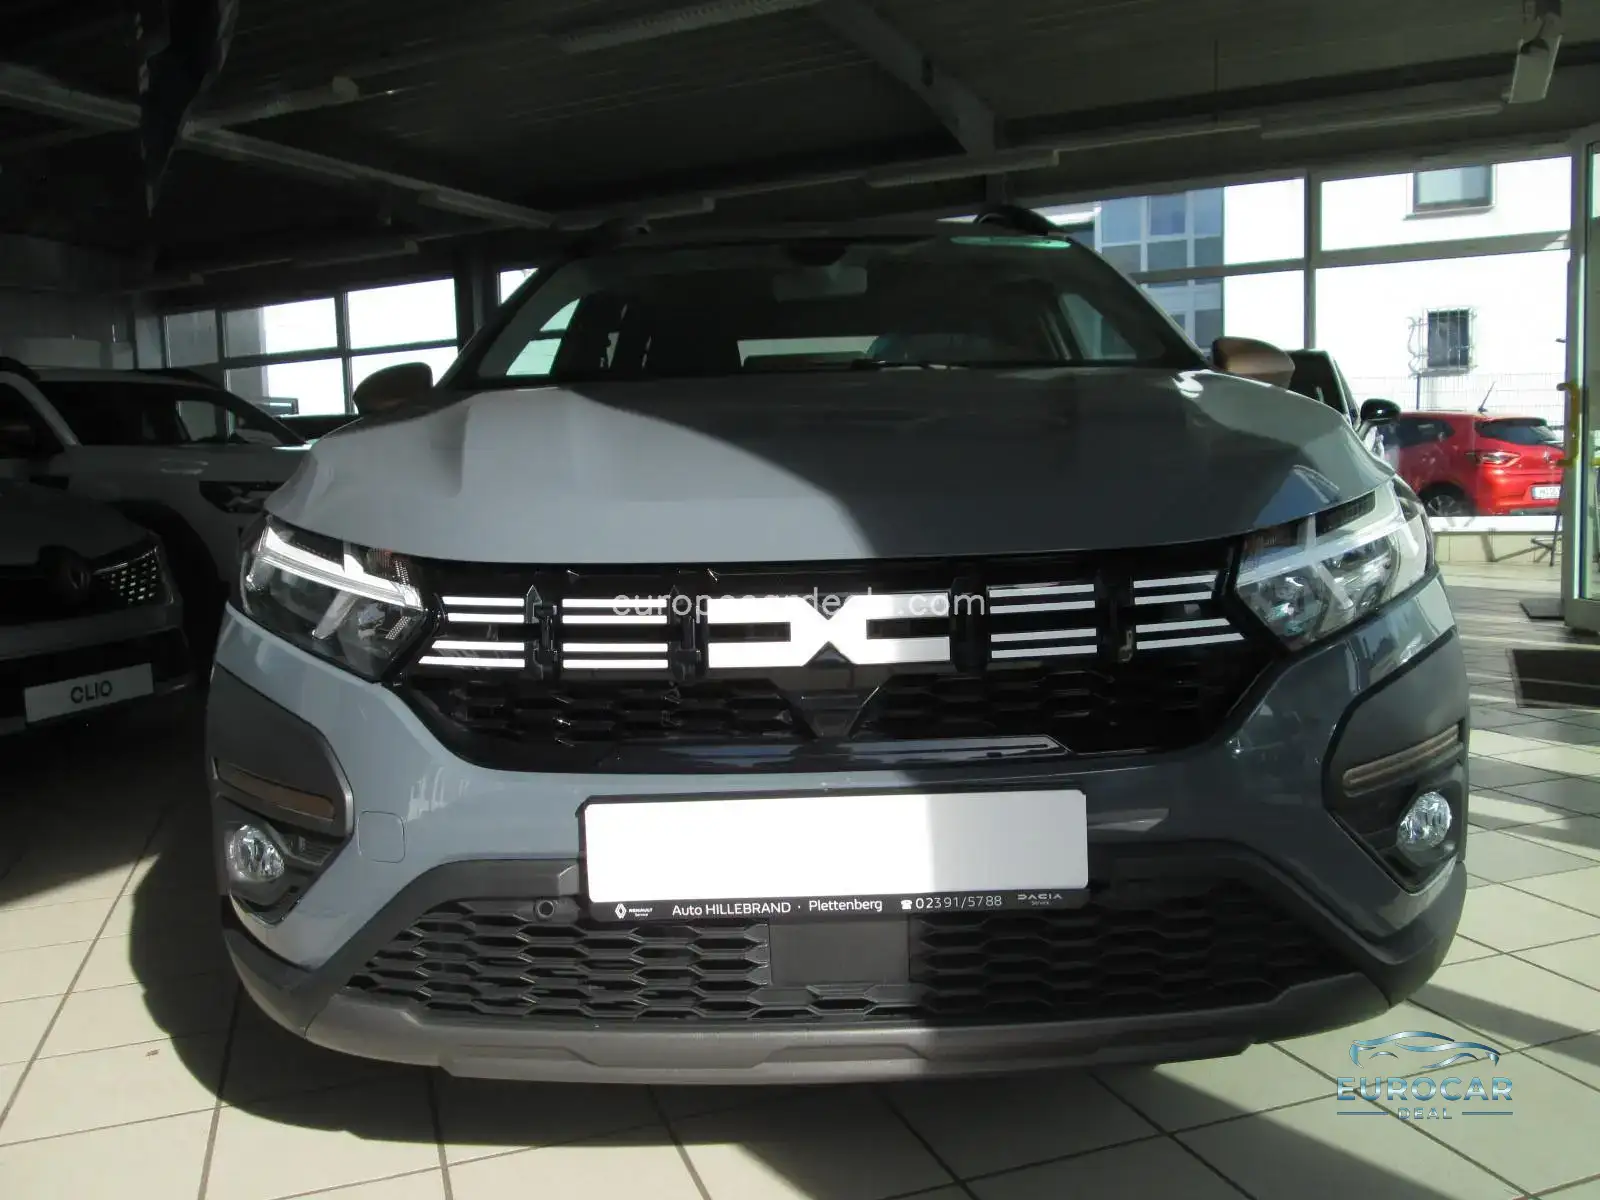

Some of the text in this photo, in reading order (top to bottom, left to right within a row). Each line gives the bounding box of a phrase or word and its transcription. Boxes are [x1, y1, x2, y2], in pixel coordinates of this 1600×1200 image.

[70, 680, 113, 703] CLIO
[672, 895, 1003, 916] Auto HILLEBRAND Plettenberg 02391/5788
